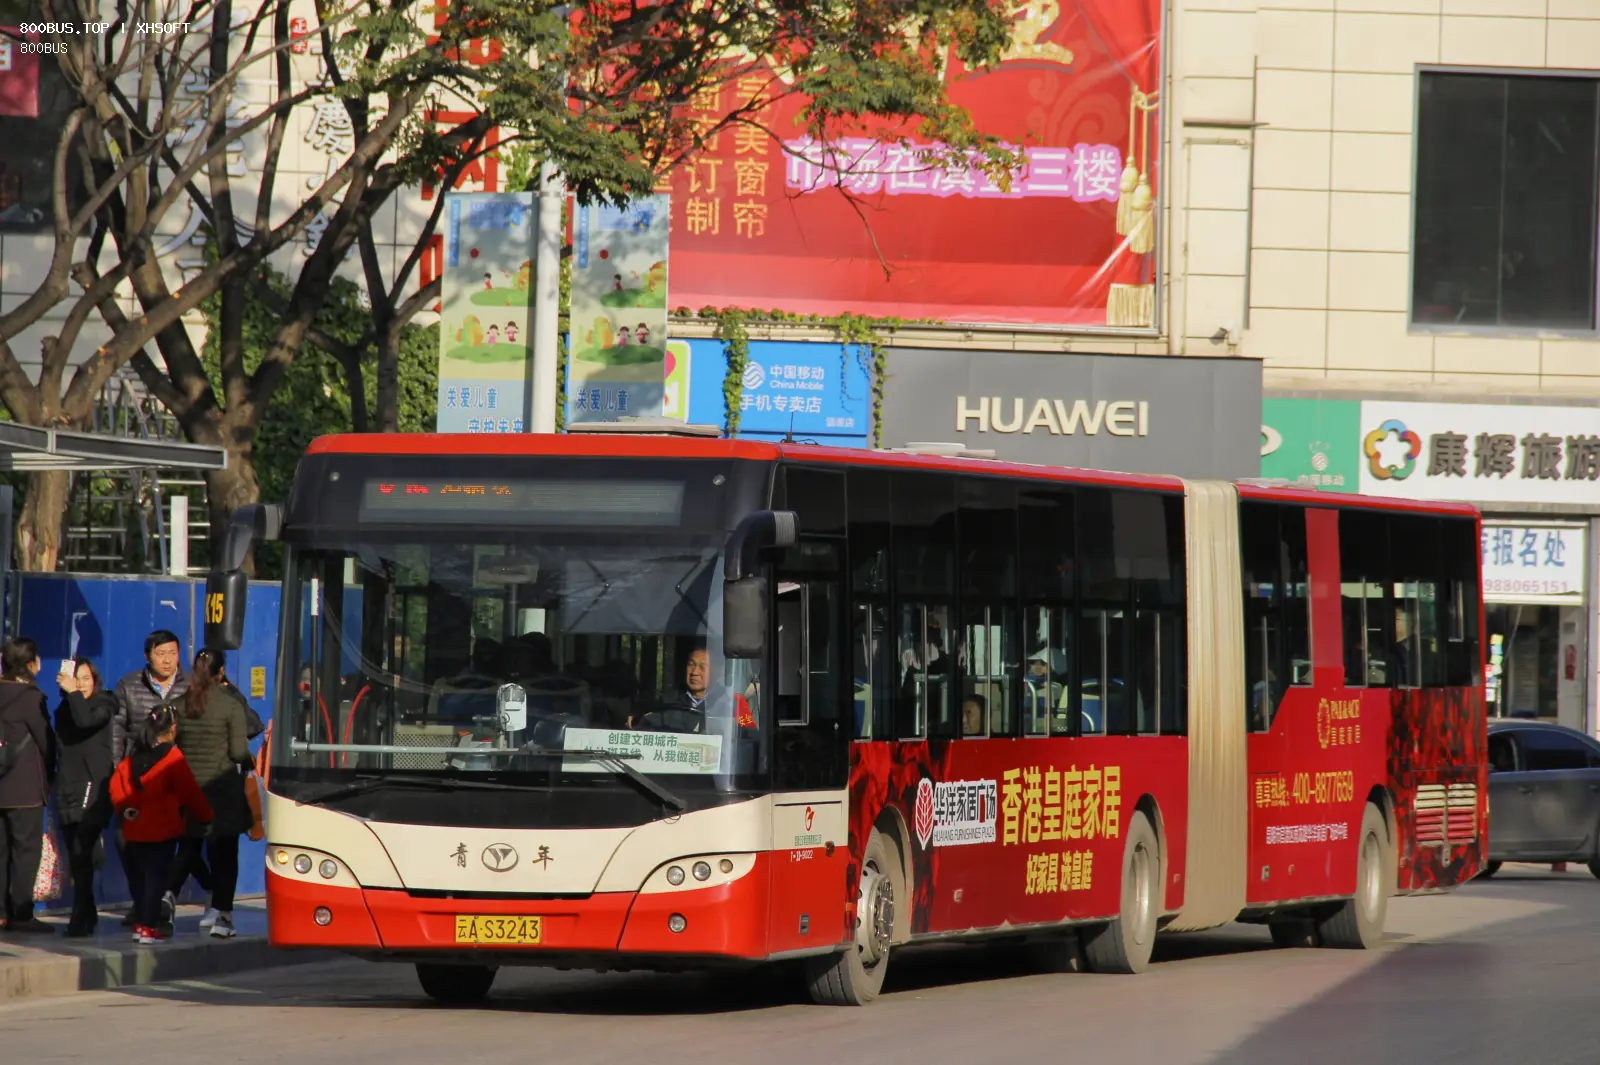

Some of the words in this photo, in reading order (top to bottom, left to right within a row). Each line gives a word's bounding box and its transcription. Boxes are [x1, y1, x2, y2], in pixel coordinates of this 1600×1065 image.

[769, 365, 825, 381] 中国移动
[770, 380, 795, 389] China
[796, 381, 825, 391] Mobile
[446, 387, 496, 409] 关爱儿童
[577, 388, 627, 411] 关爱儿童
[739, 393, 823, 413] 手机专卖店
[956, 396, 1149, 437] HUAWEI
[1427, 430, 1600, 481] 康辉旅游
[608, 732, 678, 747] 创建文明城市
[933, 783, 996, 825] 华洋家居广场
[1001, 764, 1121, 846] 香港皇庭家居
[450, 842, 468, 869] 青
[532, 845, 554, 872] 年
[457, 918, 539, 940] 云A·S3243
